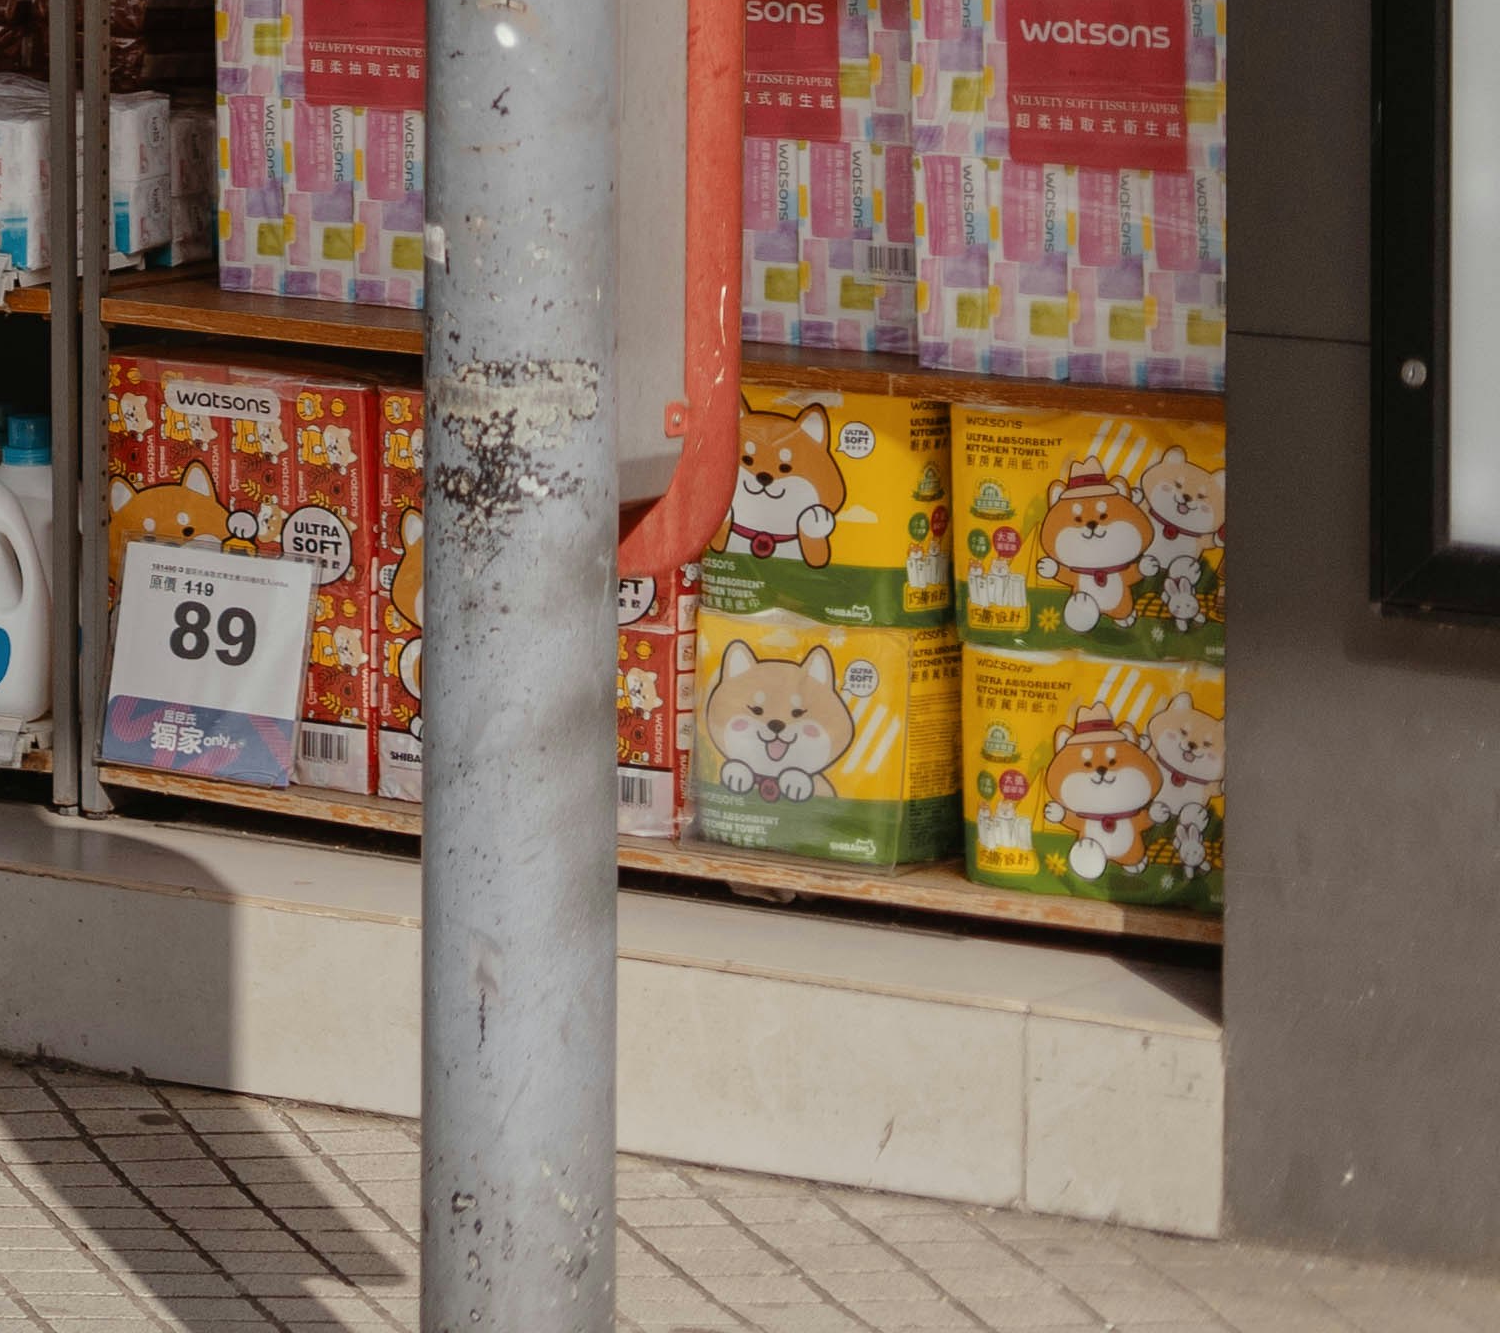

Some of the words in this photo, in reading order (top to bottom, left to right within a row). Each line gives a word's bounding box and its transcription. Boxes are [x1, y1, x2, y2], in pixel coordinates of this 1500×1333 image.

[1018, 17, 1171, 50] watsons
[308, 41, 354, 54] VELVETY
[1015, 113, 1182, 138] 超柔抽取式衛生紙
[175, 388, 272, 415] watsons
[966, 433, 998, 445] ULTRA
[1000, 435, 1062, 449] ABSORBENT
[966, 445, 1010, 456] KITCHEN
[1012, 446, 1049, 457] TOWEL
[292, 523, 341, 542] ULTRA
[292, 537, 343, 557] SOFT
[149, 574, 177, 592] 原價
[185, 580, 214, 597] 119
[169, 601, 256, 665] 89
[975, 675, 1004, 686] ULTRA
[1005, 678, 1072, 691] ABSORBENT
[975, 686, 1019, 698] KITCHEN
[1020, 688, 1058, 701] TOWEL
[150, 721, 202, 754] 獨家
[203, 733, 230, 749] only
